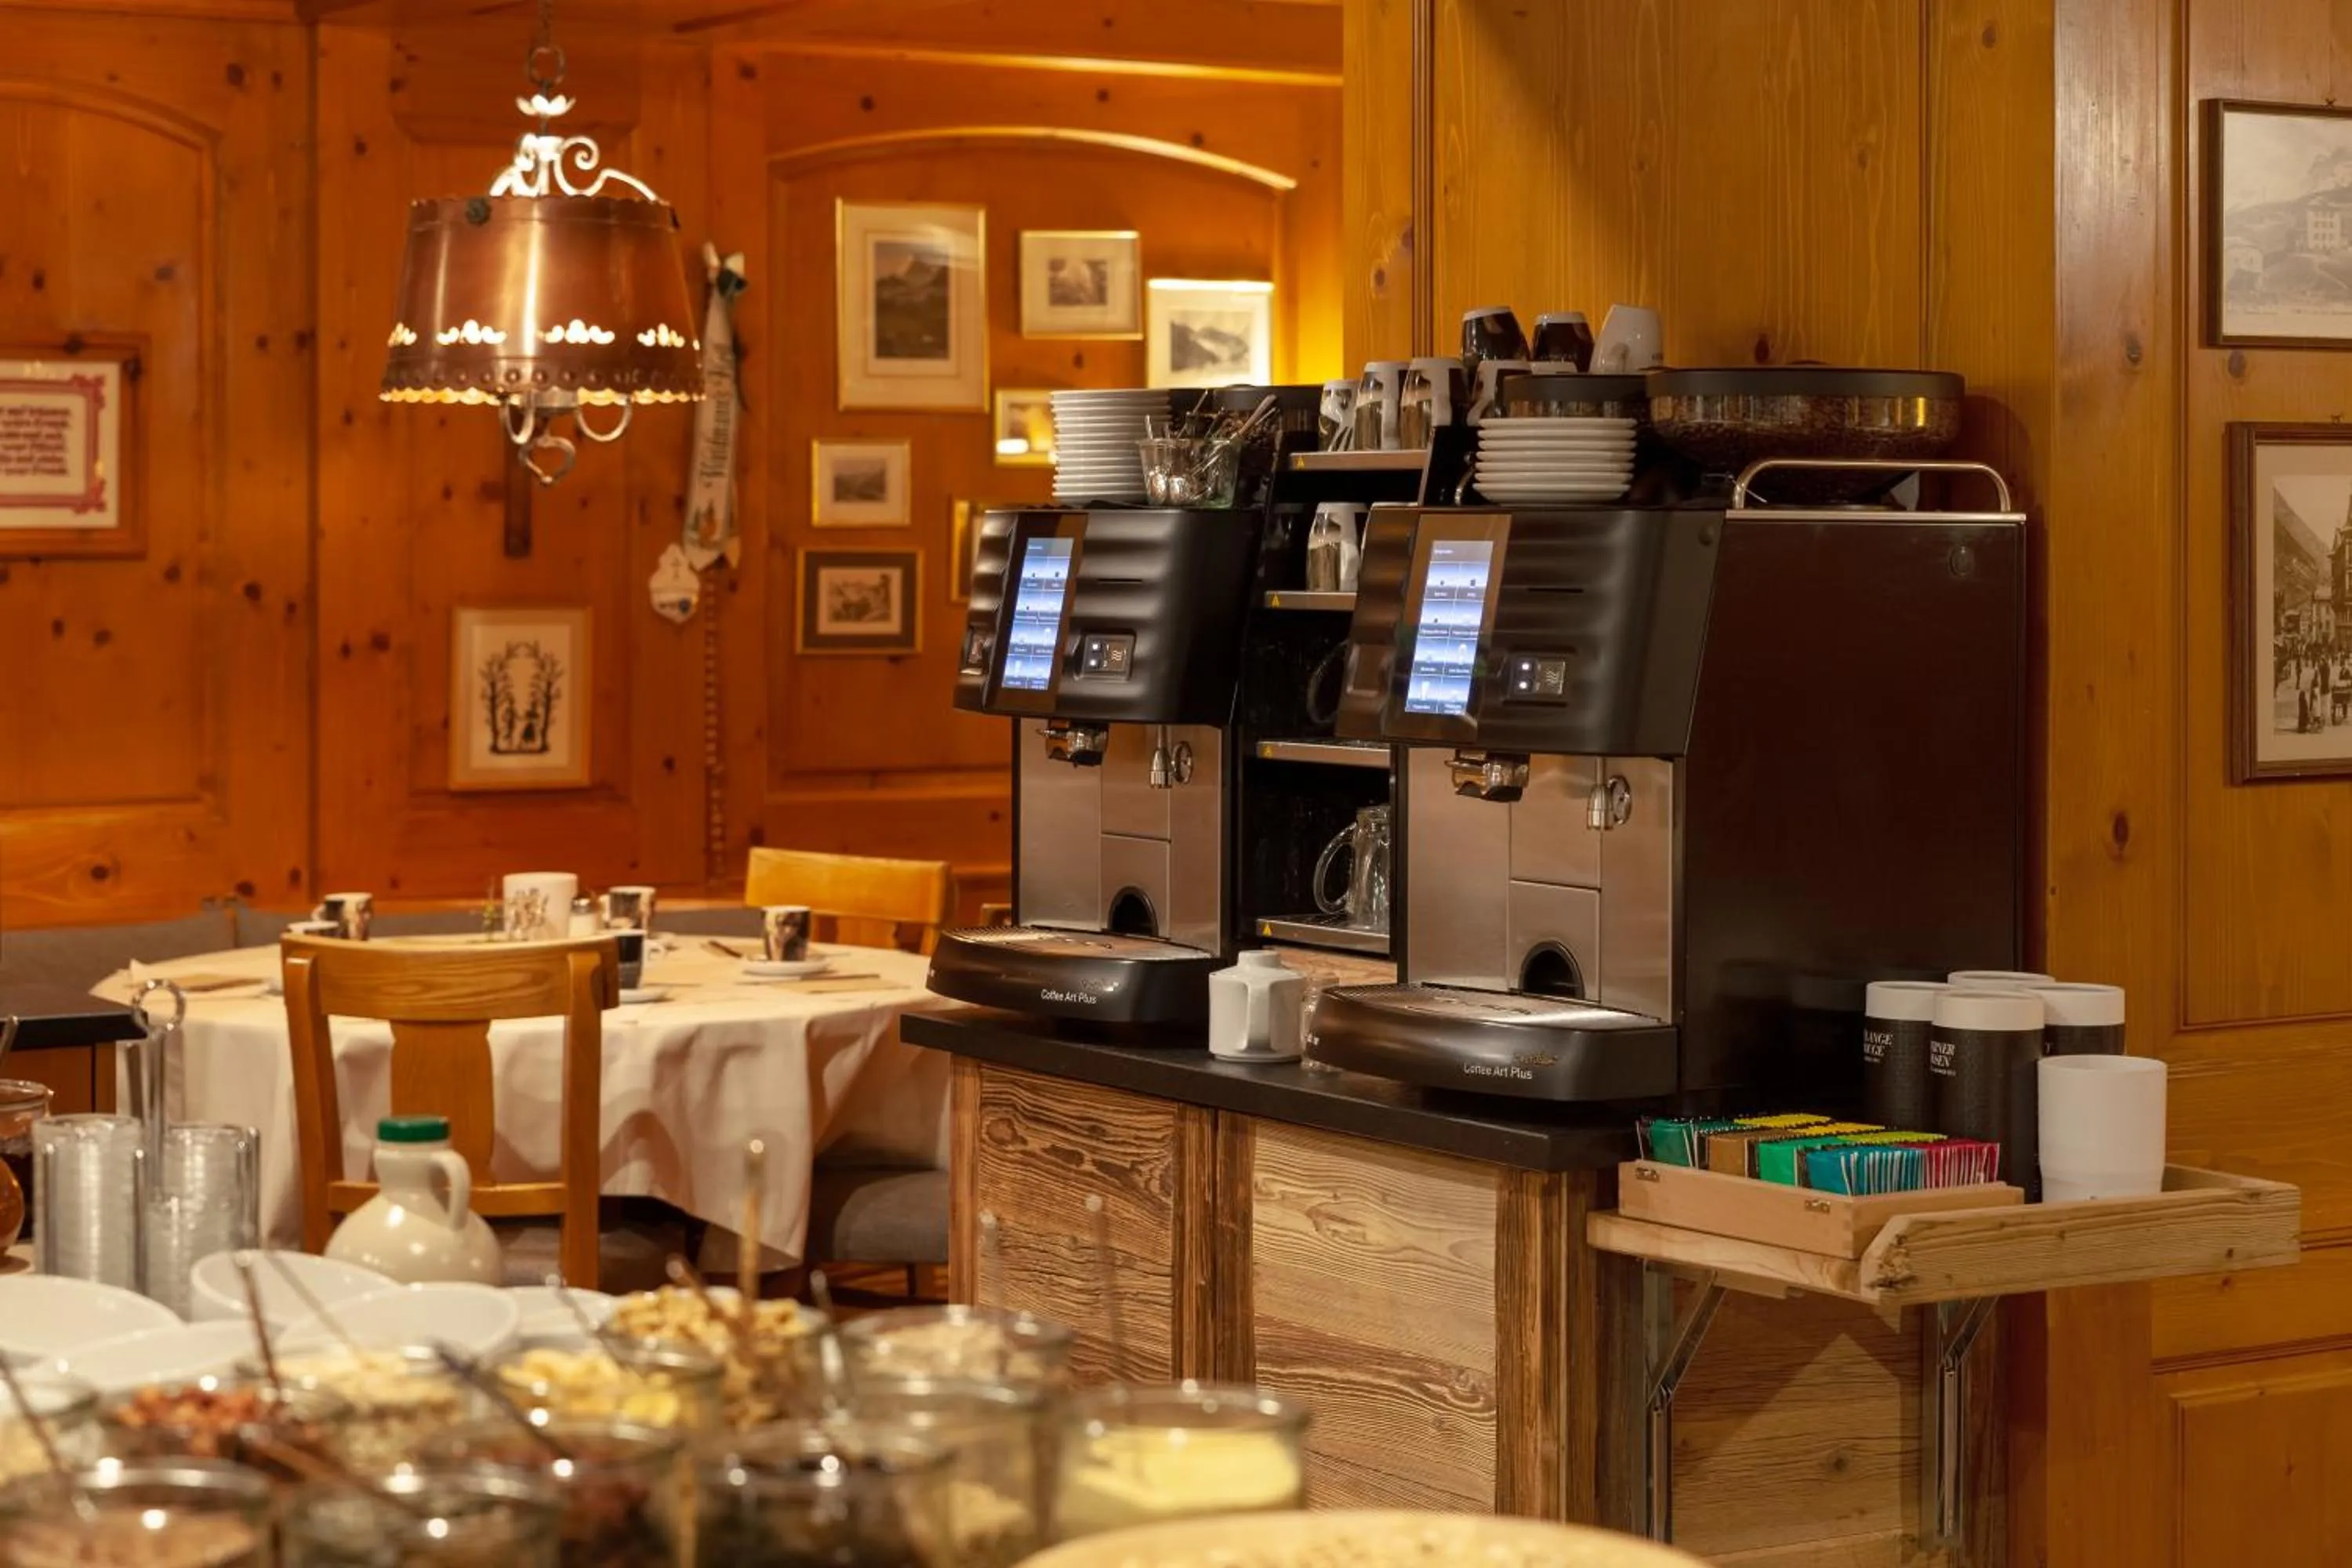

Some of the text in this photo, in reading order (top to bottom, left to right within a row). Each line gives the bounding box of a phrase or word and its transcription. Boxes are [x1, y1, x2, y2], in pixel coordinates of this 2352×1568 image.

[1041, 989, 1097, 1004] Coffee Art Plus
[1494, 1066, 1508, 1078] Art
[1511, 1066, 1533, 1080] Plus
